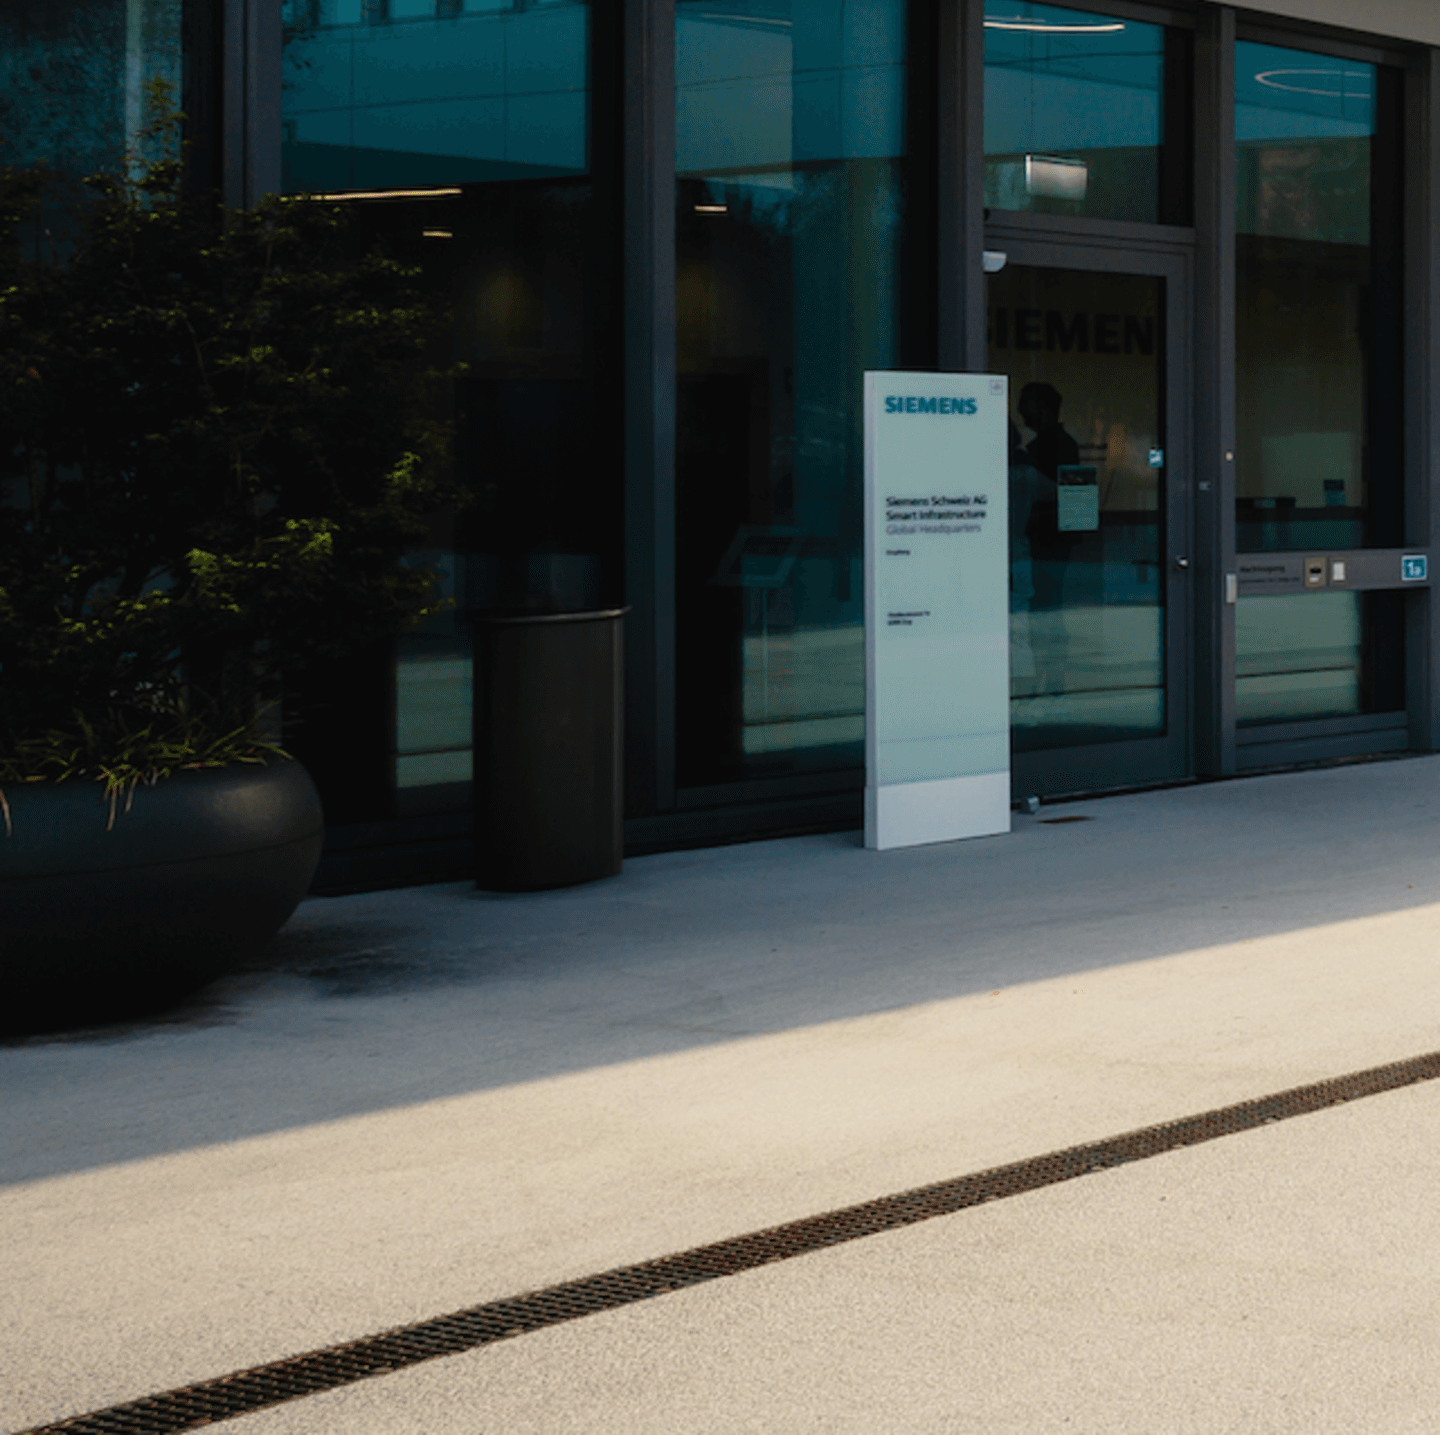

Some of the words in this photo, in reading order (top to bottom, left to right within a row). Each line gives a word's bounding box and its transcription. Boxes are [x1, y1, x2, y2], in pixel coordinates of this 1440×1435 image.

[986, 306, 1155, 356] IEMEN
[885, 396, 978, 415] SIEMENS
[885, 496, 929, 507] Siemens
[931, 494, 971, 506] Schweiz
[974, 493, 988, 505] AG
[885, 510, 916, 521] Smart
[919, 509, 987, 520] Infrastructure
